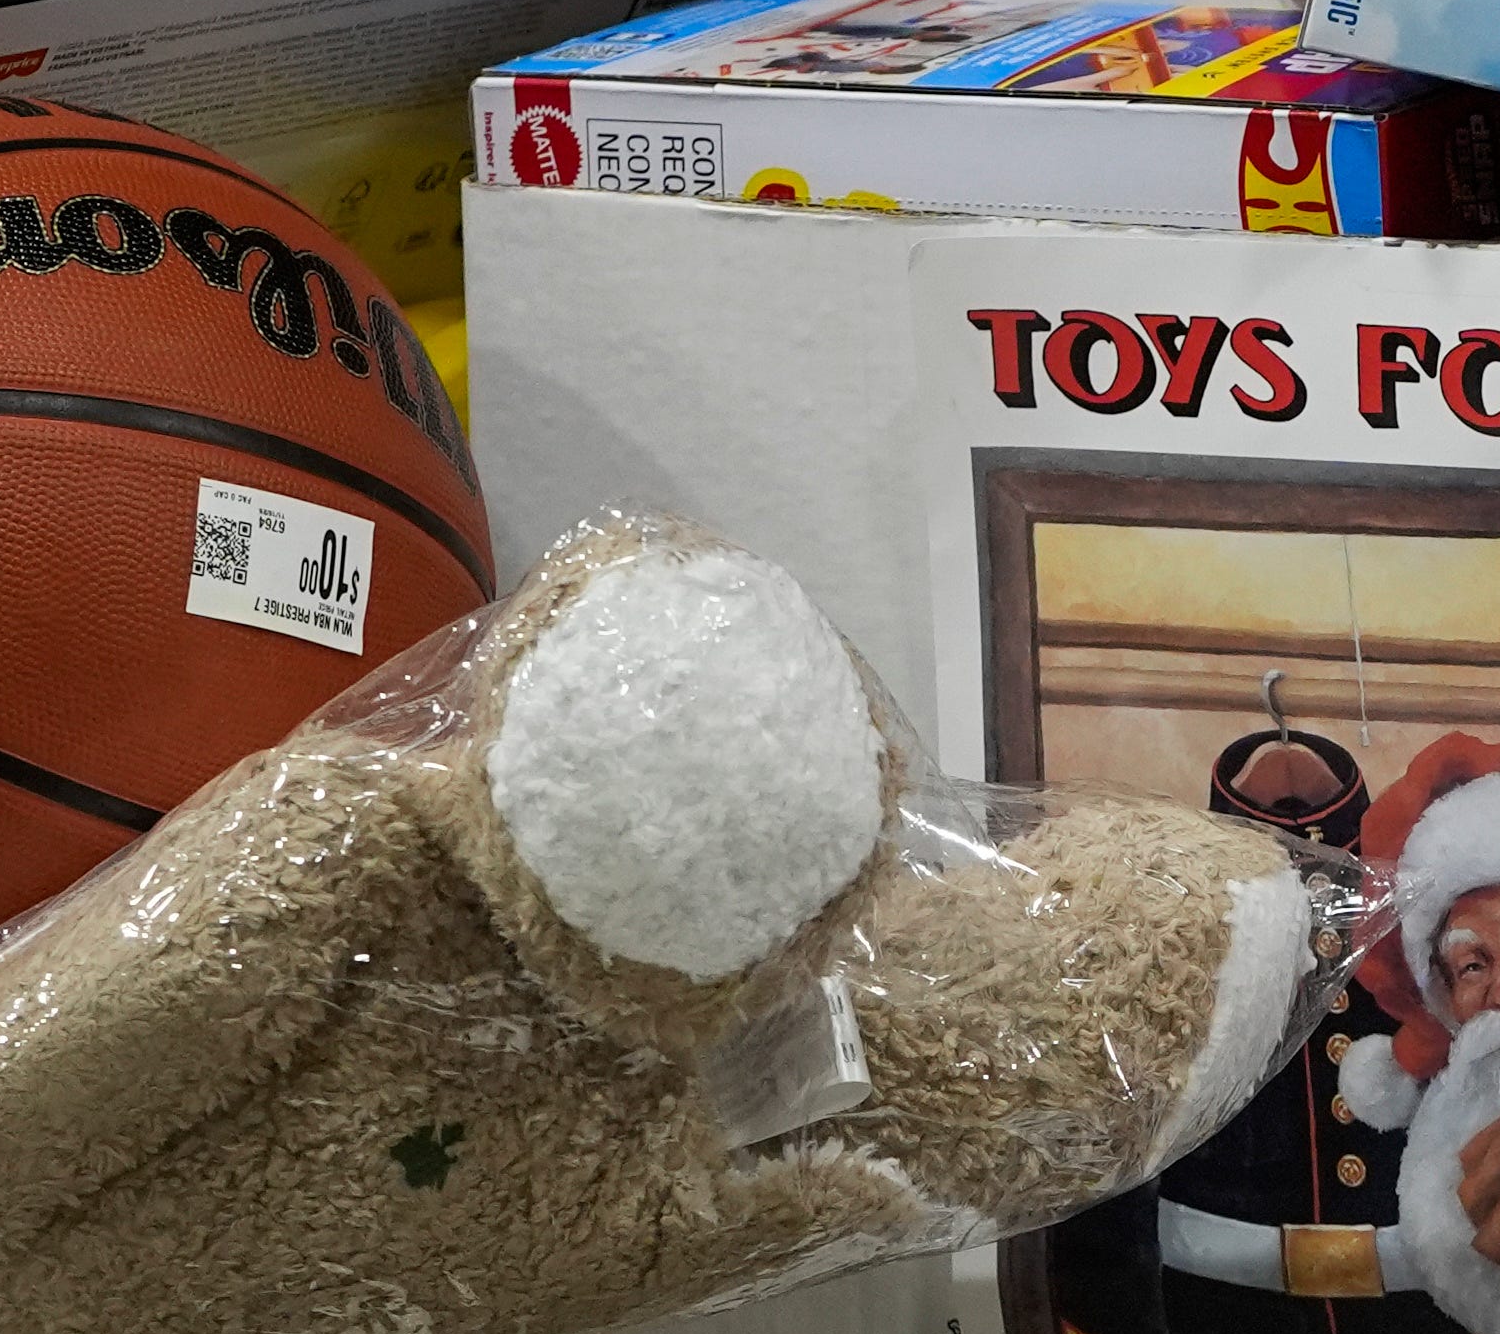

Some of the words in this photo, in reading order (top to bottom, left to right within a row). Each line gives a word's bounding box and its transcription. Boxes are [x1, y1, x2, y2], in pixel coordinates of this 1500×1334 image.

[530, 117, 561, 186] MATTE
[662, 135, 685, 193] REQ
[967, 308, 1306, 421] TOYS
[259, 516, 285, 534] 6764
[254, 597, 261, 611] 7
[264, 599, 311, 624] PRESTIGE
[314, 611, 330, 629] NBA
[334, 621, 353, 637] WLN
